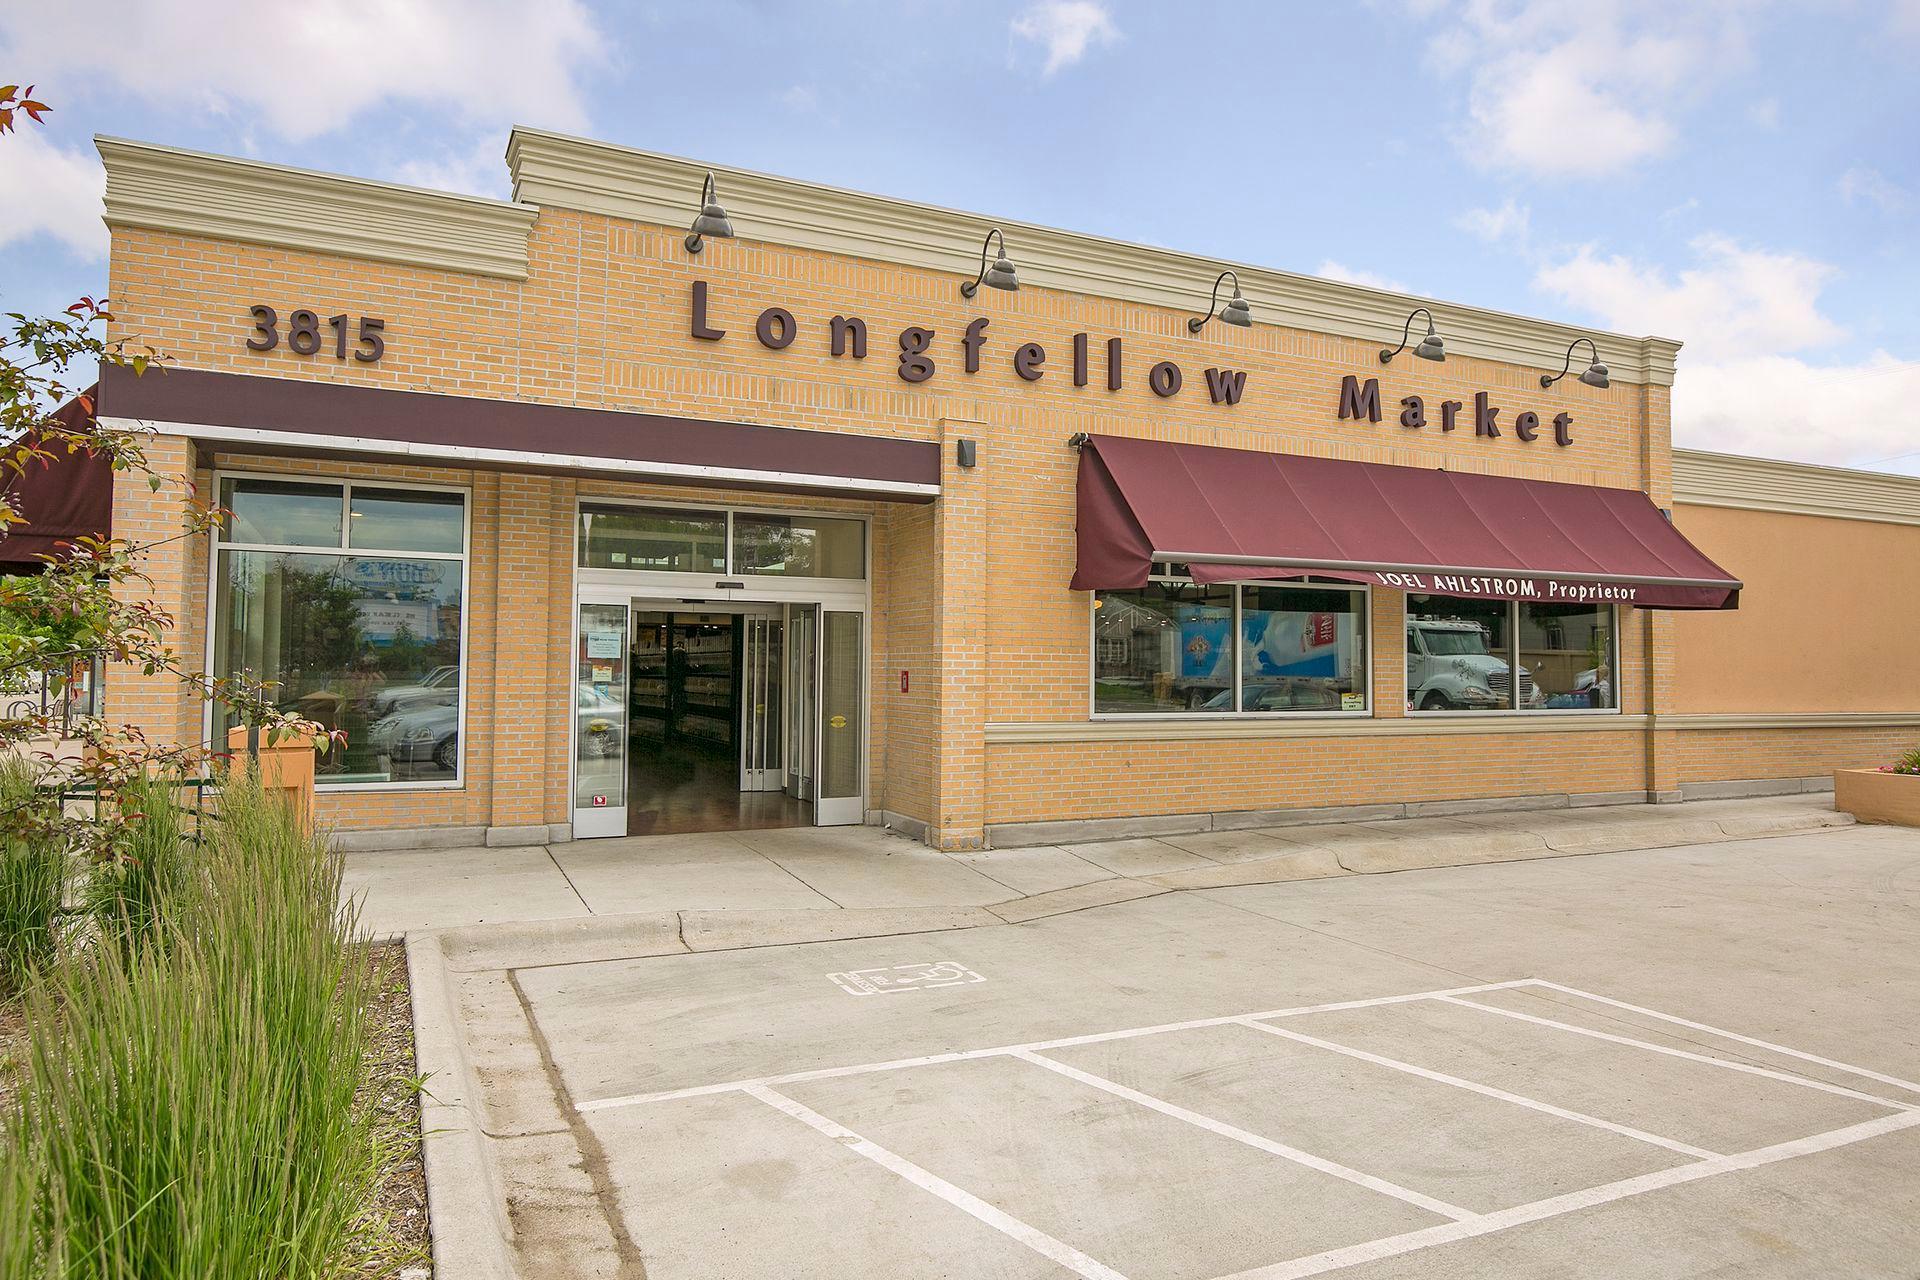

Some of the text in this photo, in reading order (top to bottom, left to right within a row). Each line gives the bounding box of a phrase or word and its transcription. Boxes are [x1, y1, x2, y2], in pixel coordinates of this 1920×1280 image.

[246, 304, 385, 364] 3815
[690, 280, 1574, 448] Longfellow Market
[1375, 572, 1637, 603] JOEL AHLSTROM, Proprietor
